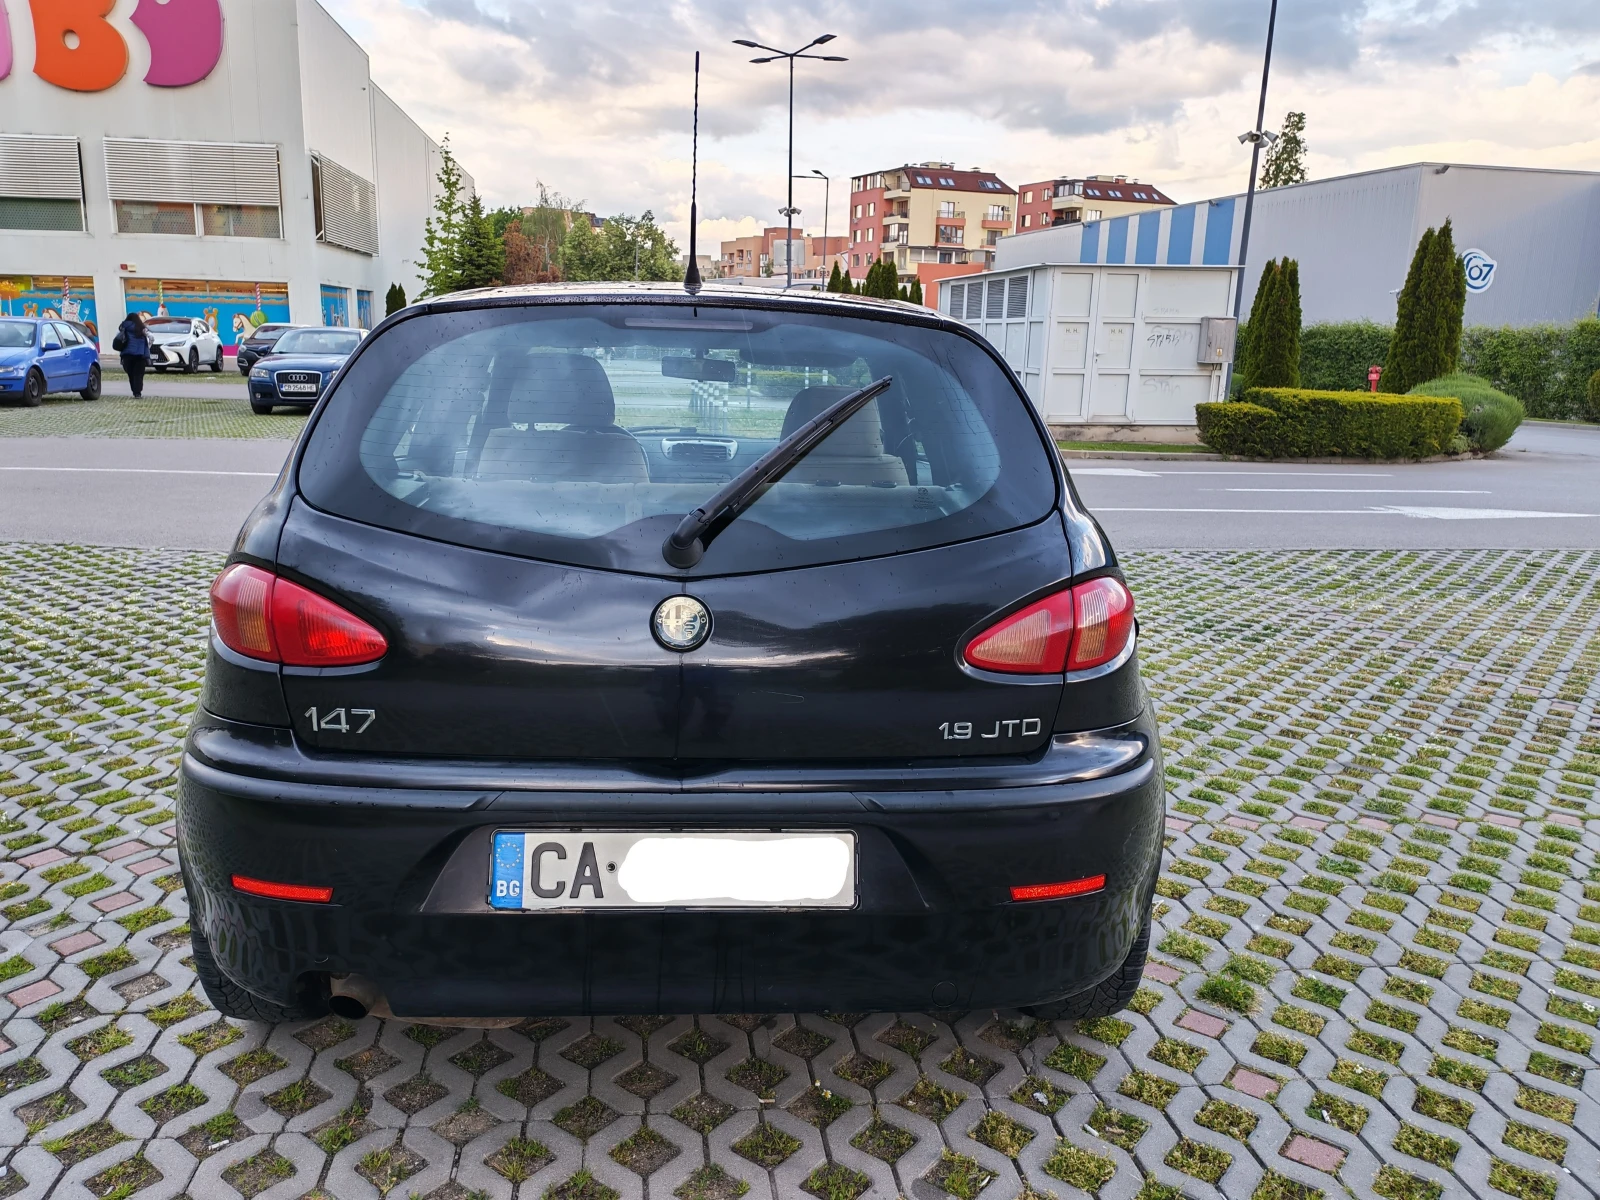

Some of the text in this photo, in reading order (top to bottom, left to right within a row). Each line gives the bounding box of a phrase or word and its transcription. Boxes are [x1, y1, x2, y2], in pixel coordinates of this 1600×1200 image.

[304, 706, 376, 734] 147
[981, 718, 1041, 738] JTD
[531, 842, 604, 899] CA
[496, 880, 520, 897] BG
